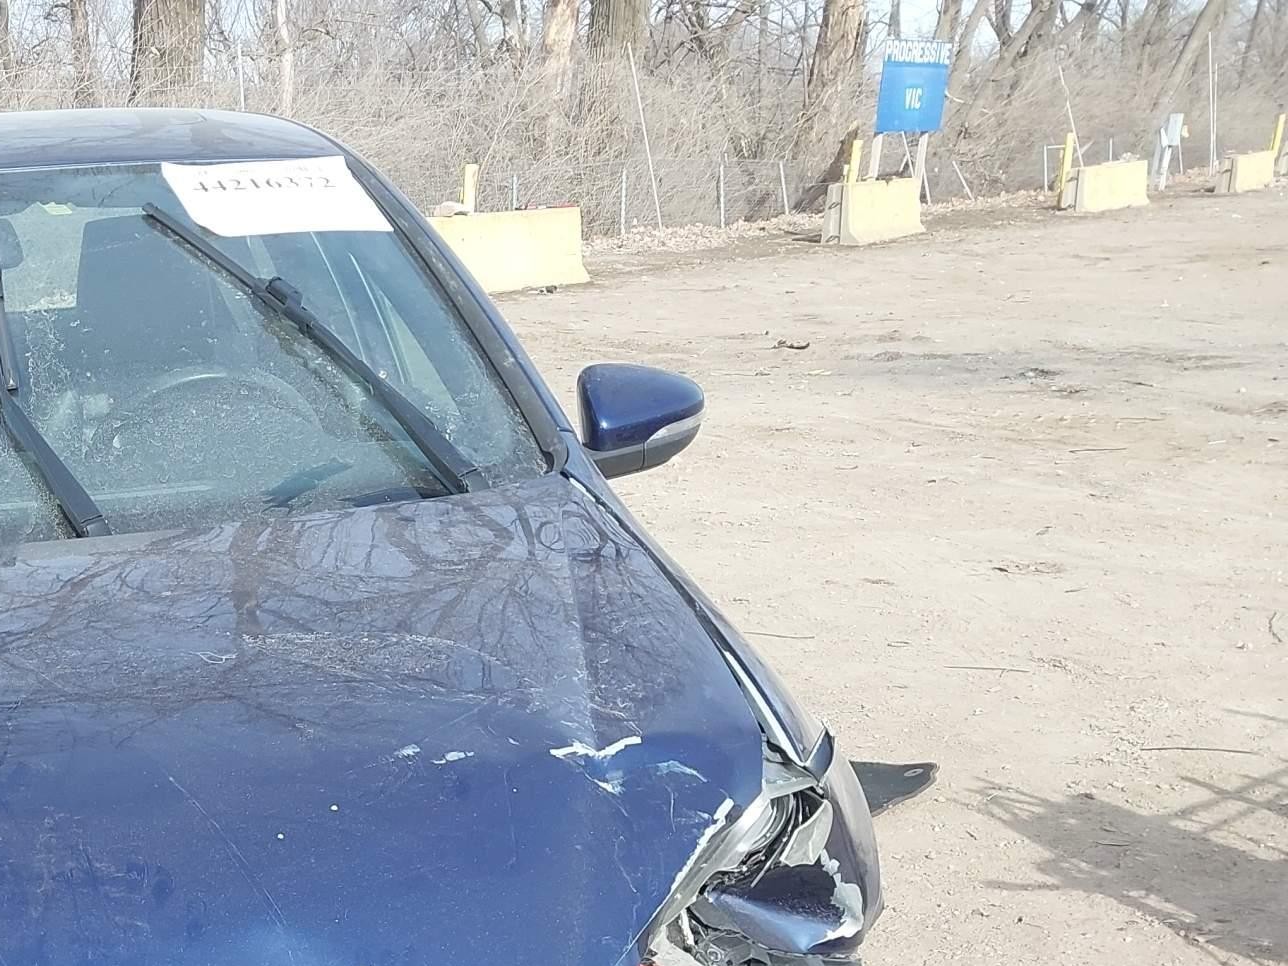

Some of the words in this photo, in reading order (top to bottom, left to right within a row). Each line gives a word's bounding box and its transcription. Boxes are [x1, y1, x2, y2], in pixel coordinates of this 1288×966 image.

[884, 40, 952, 64] PROGRESSIVE
[905, 87, 923, 110] VIC
[192, 176, 337, 193] 44216372
